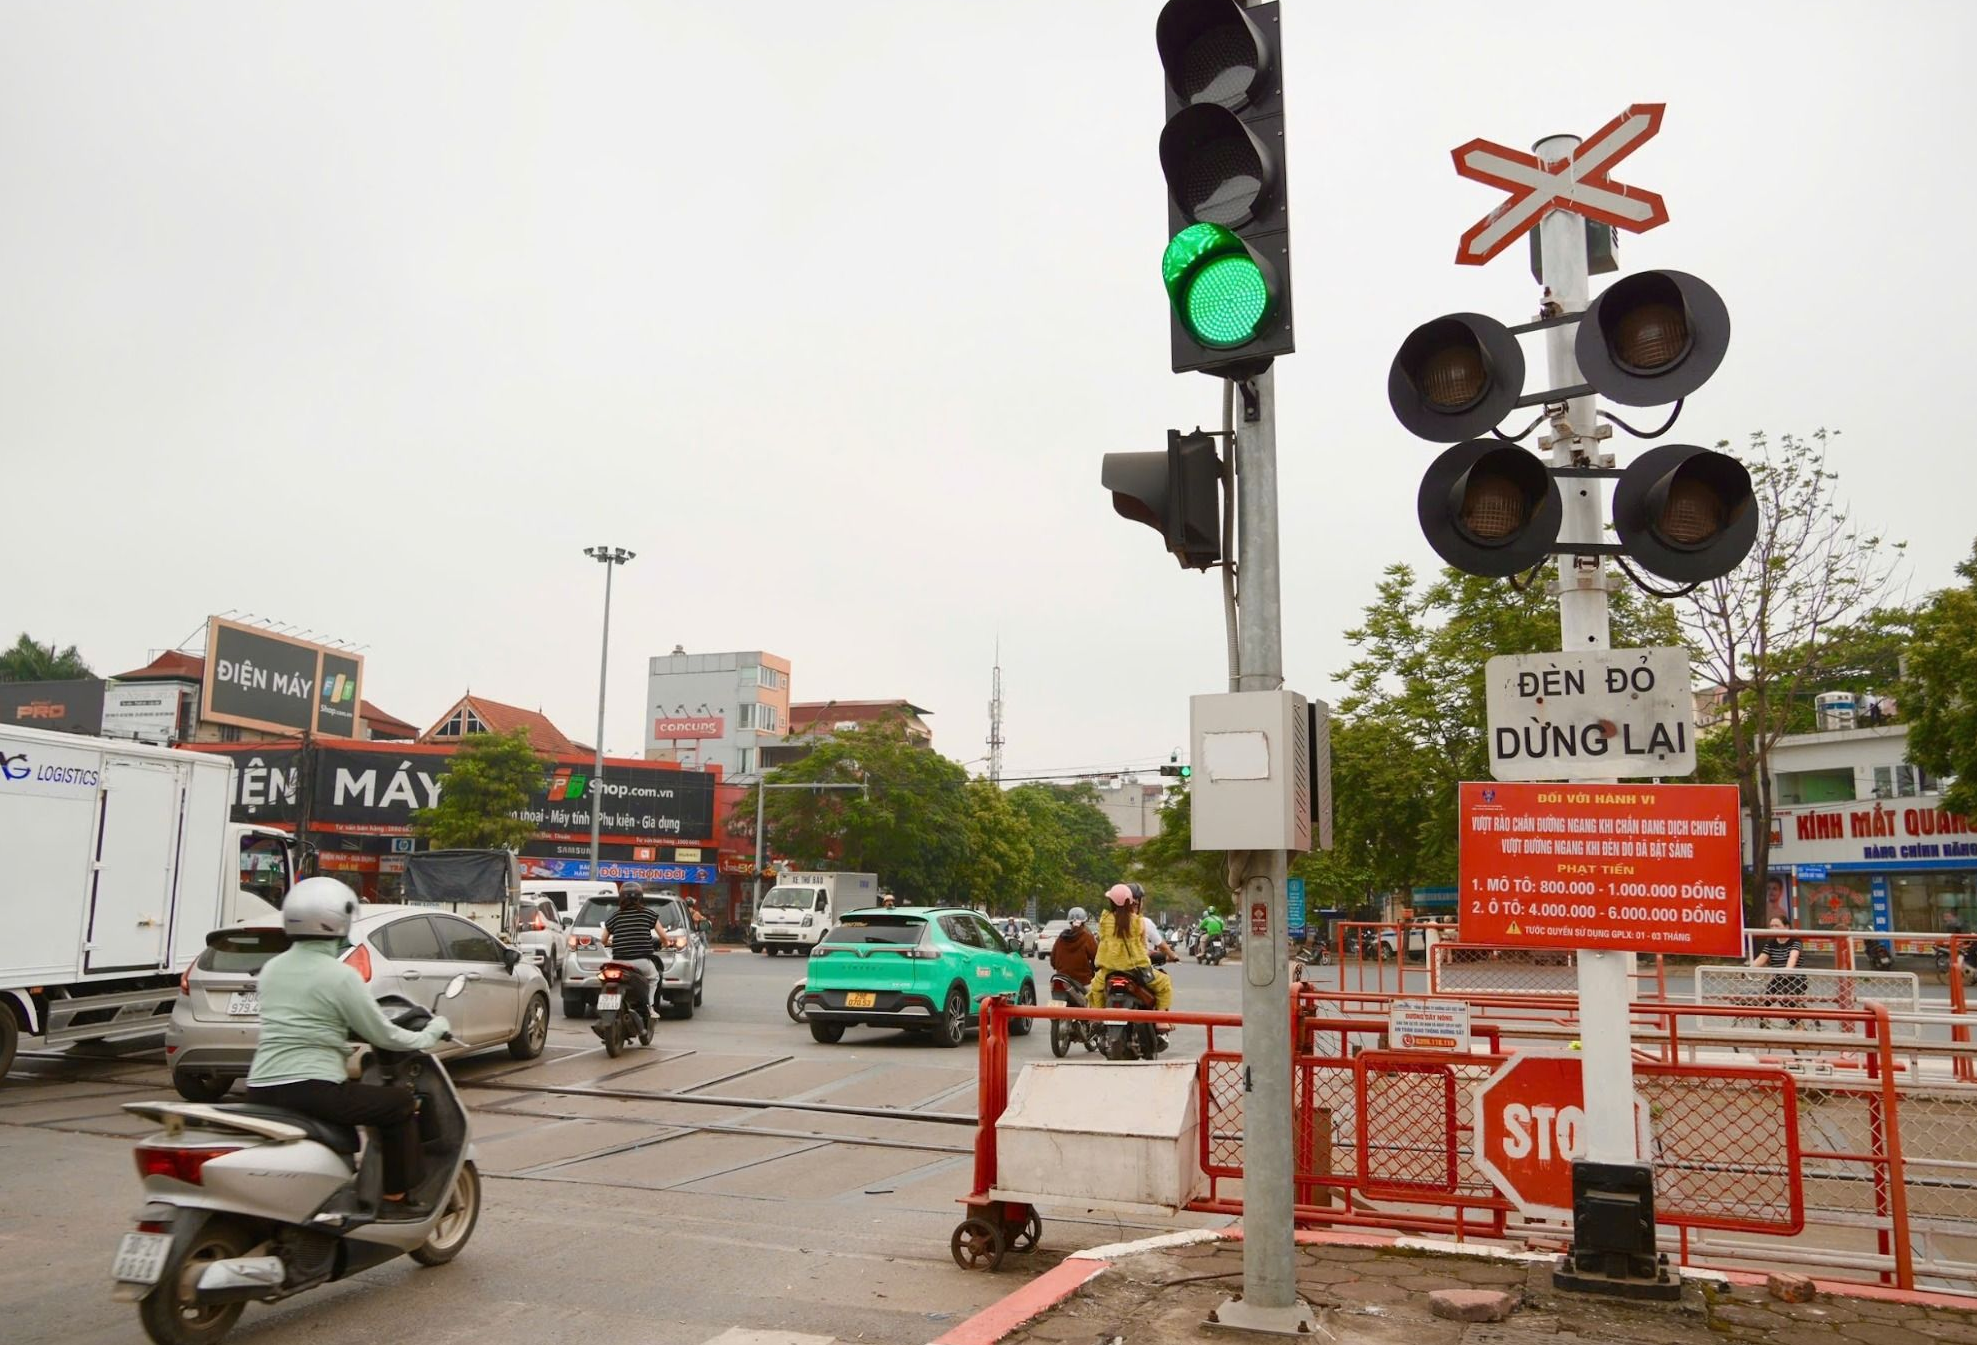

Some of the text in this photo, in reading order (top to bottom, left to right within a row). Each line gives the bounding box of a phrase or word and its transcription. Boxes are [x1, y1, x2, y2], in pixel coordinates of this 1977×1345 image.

[217, 659, 313, 699] ĐIỆN MÁY
[1517, 655, 1655, 697] ĐÈN ĐỎ
[1496, 716, 1686, 760] DỪNG LẠI
[37, 765, 99, 786] LOGISTICS
[230, 757, 444, 813] IỆN MÁY
[1537, 791, 1656, 805] ĐỐI VỚI HÀNH VI
[550, 809, 570, 827] Máy
[572, 811, 590, 825] tính
[616, 812, 635, 830] kiện
[642, 815, 656, 829] Gia
[658, 815, 681, 833] dụng
[1471, 815, 1492, 835] VƯỢT
[1567, 817, 1597, 834] NGANG
[1598, 818, 1614, 834] KHI
[1667, 820, 1689, 839] DỊCH
[1797, 810, 1843, 840] KÍNH
[1851, 802, 1896, 838] MẮT
[556, 846, 592, 855] SAMSUN
[1501, 837, 1522, 858] VƯỢT
[1554, 840, 1584, 856] NGANG
[1585, 841, 1600, 856] KHI
[1602, 838, 1620, 857] ĐÈN
[1668, 839, 1694, 859] SÁNG
[1557, 864, 1597, 876] PHẠT
[1471, 878, 1483, 891] 1.
[1486, 875, 1510, 892] MÔ
[1513, 876, 1536, 893] TÔ:
[1540, 880, 1596, 895] 800.000
[1607, 882, 1677, 898] 1.000.000
[1681, 879, 1726, 900] ĐỒNG
[1471, 900, 1485, 914] 2.
[1488, 898, 1499, 915] Ô
[1502, 899, 1525, 915] TÔ:
[1528, 902, 1596, 918] 4.000.000
[1607, 905, 1678, 922] 6.000.000
[1681, 903, 1727, 924] ĐỒNG
[1635, 931, 1645, 940] 01
[1663, 931, 1691, 942] THÁNG
[1503, 1103, 1586, 1161] STO
